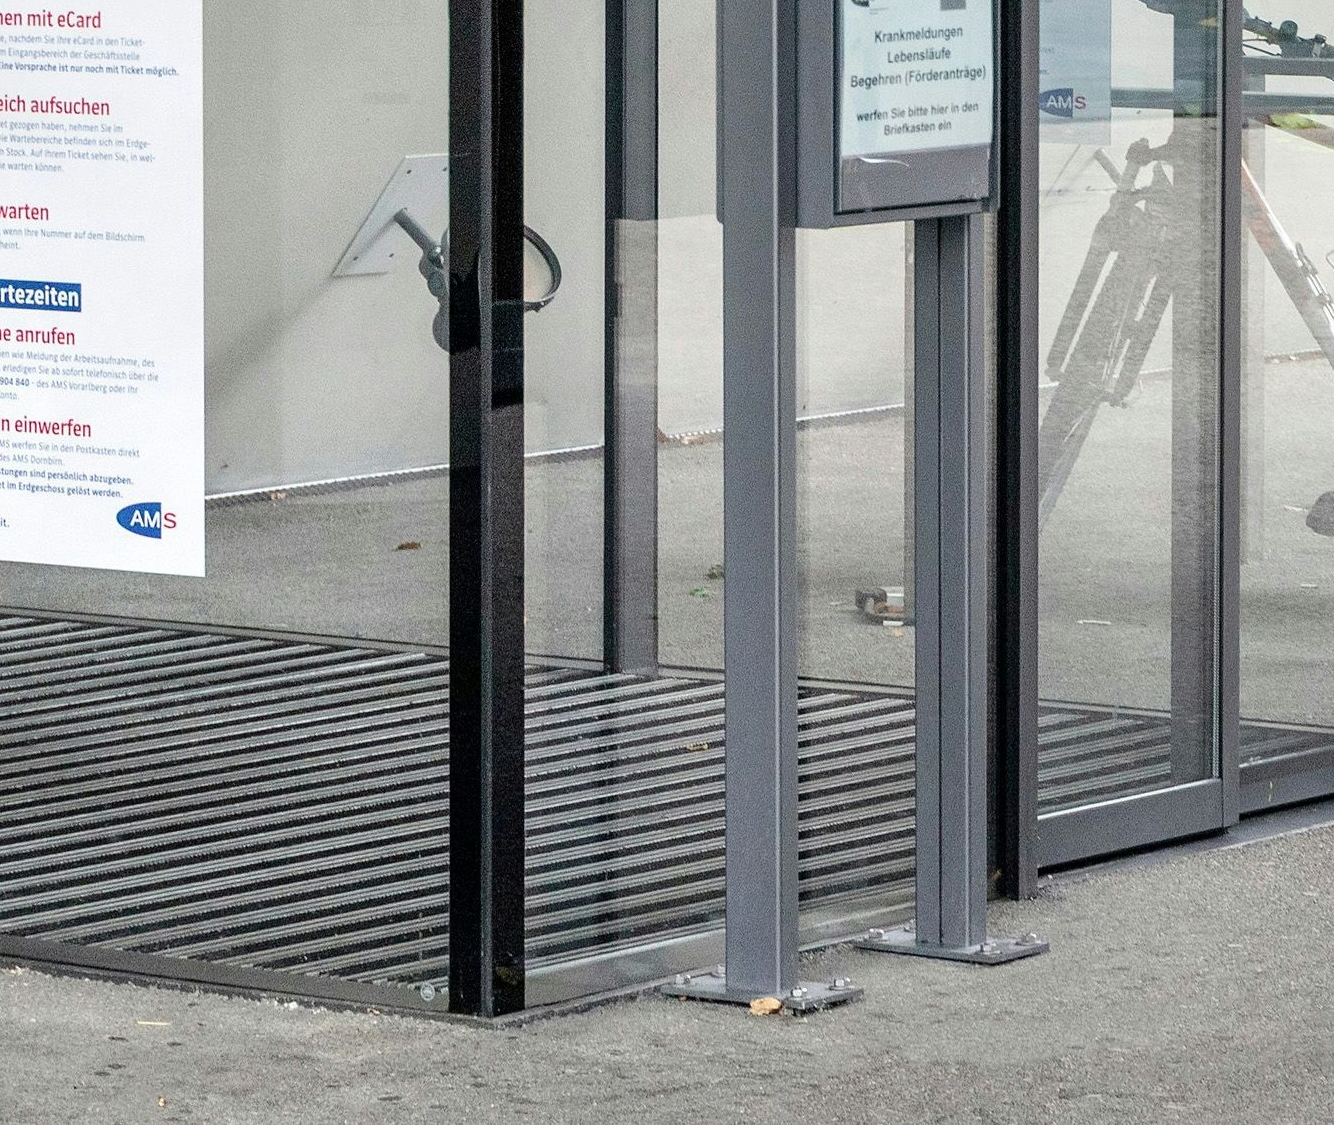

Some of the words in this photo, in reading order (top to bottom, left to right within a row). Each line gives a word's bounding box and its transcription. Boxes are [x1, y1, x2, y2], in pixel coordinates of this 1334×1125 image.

[27, 9, 53, 27] mit
[57, 11, 100, 28] eCard
[874, 27, 963, 42] Krankmeldungen
[887, 47, 951, 63] Lebensläufe
[14, 62, 56, 71] Vorsprache
[85, 65, 103, 73] noch
[120, 65, 143, 74] Ticket
[145, 67, 179, 77] möglich.
[850, 74, 901, 89] Begehren
[905, 65, 985, 81] (Förderanträge)
[30, 96, 109, 115] aufsuchen
[1046, 94, 1087, 110] AMS
[856, 109, 887, 121] werfen
[891, 108, 905, 118] Sie
[908, 107, 927, 116] bitte
[962, 102, 978, 112] den
[884, 123, 935, 135] Briefkasten
[938, 121, 951, 130] ein
[15, 326, 75, 345] anrufen
[14, 415, 91, 437] einwerfen
[47, 472, 87, 480] persönlich
[89, 474, 134, 485] abzugeben.
[18, 481, 64, 493] Erdgeschoss
[67, 486, 89, 495] gelöst
[92, 489, 123, 497] werden.
[130, 512, 177, 528] AMS
